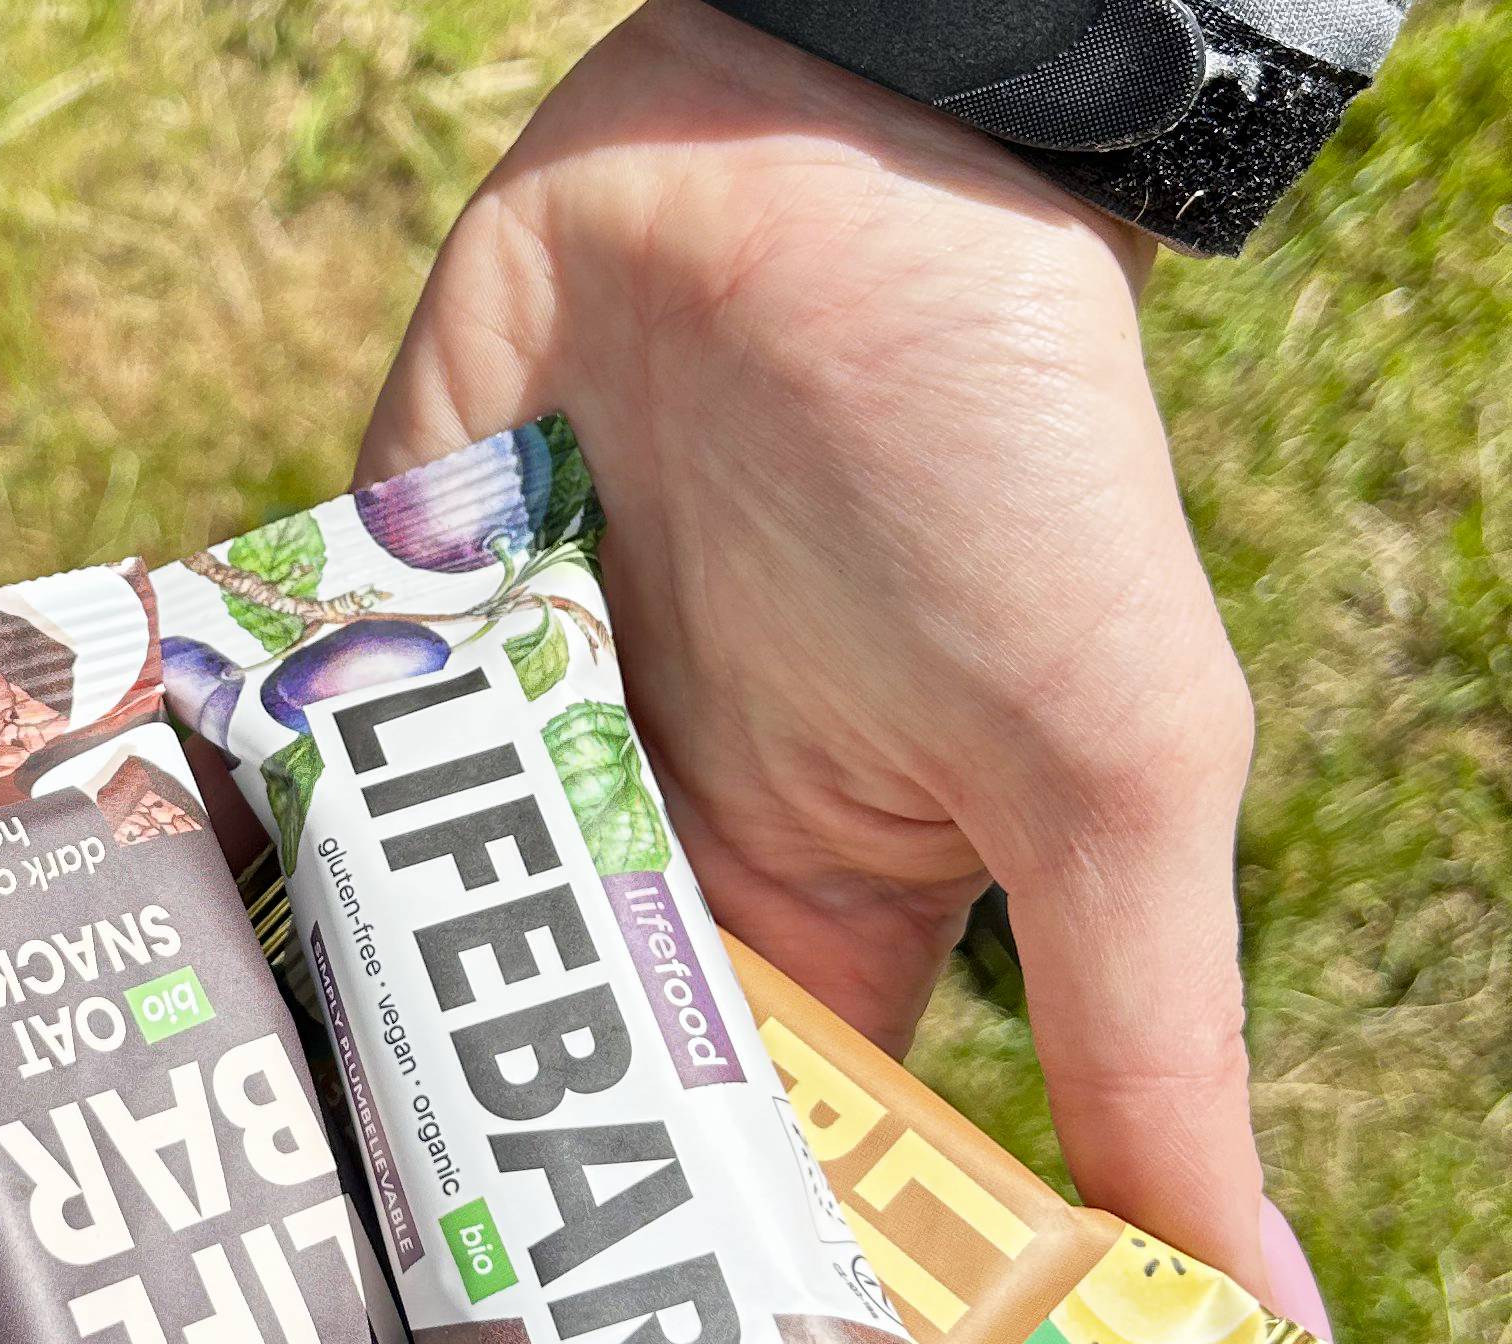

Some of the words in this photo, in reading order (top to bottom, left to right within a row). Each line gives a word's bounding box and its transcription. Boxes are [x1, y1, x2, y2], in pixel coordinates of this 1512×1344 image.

[29, 834, 109, 888] dark
[143, 985, 201, 1027] bio
[317, 835, 385, 979] gluten-free
[377, 993, 419, 1078] vegan
[410, 1093, 462, 1198] organic
[621, 884, 729, 1069] lifefood
[16, 993, 128, 1079] OAT
[310, 941, 345, 1029] SIMPLY
[338, 1035, 414, 1255] PLUMBELIEVABLE
[458, 1223, 496, 1278] bio
